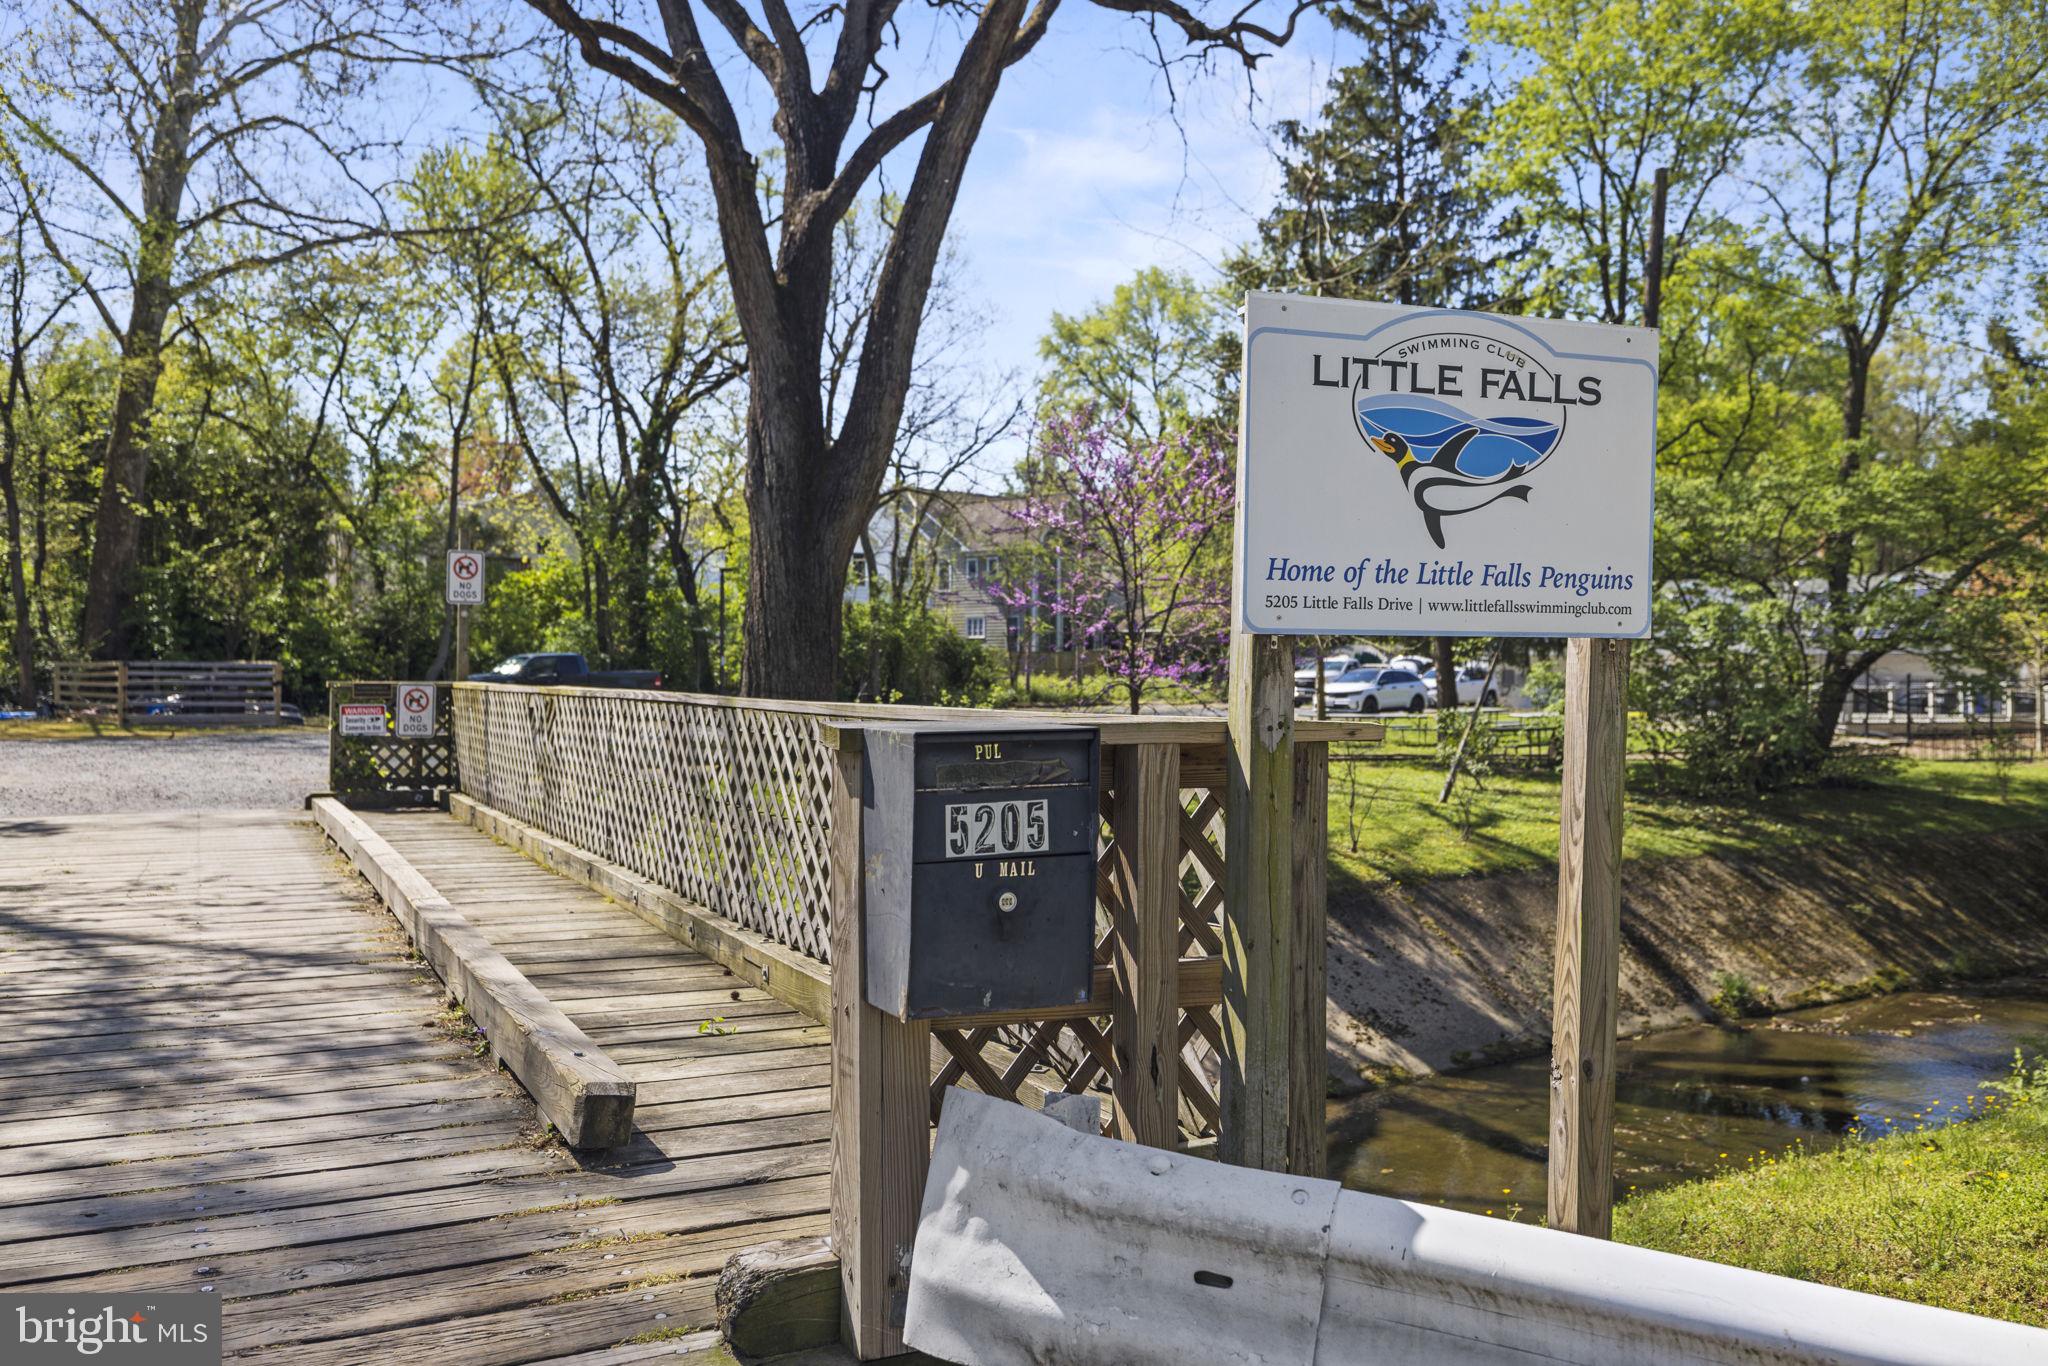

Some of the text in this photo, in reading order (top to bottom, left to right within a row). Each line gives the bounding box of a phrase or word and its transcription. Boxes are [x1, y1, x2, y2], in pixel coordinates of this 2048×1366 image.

[1398, 337, 1526, 369] SWIMMING CLUB
[1312, 354, 1602, 407] LITTLE FALLS
[1265, 557, 1634, 597] Home of the Little Falls Penguins
[459, 582, 472, 590] NO
[453, 591, 477, 599] DOGS
[1265, 595, 1298, 609] 5205
[1302, 596, 1339, 610] Little
[1343, 596, 1374, 611] Falls
[1378, 597, 1413, 611] Drive
[1428, 599, 1632, 618] www.littlefallsswimmingclub.com
[344, 707, 382, 715] WARNING
[409, 715, 422, 723] NO
[403, 724, 428, 732] DOGS
[975, 744, 1002, 760] PUL
[950, 801, 1045, 855] 5205
[975, 861, 1035, 879] U MAIL
